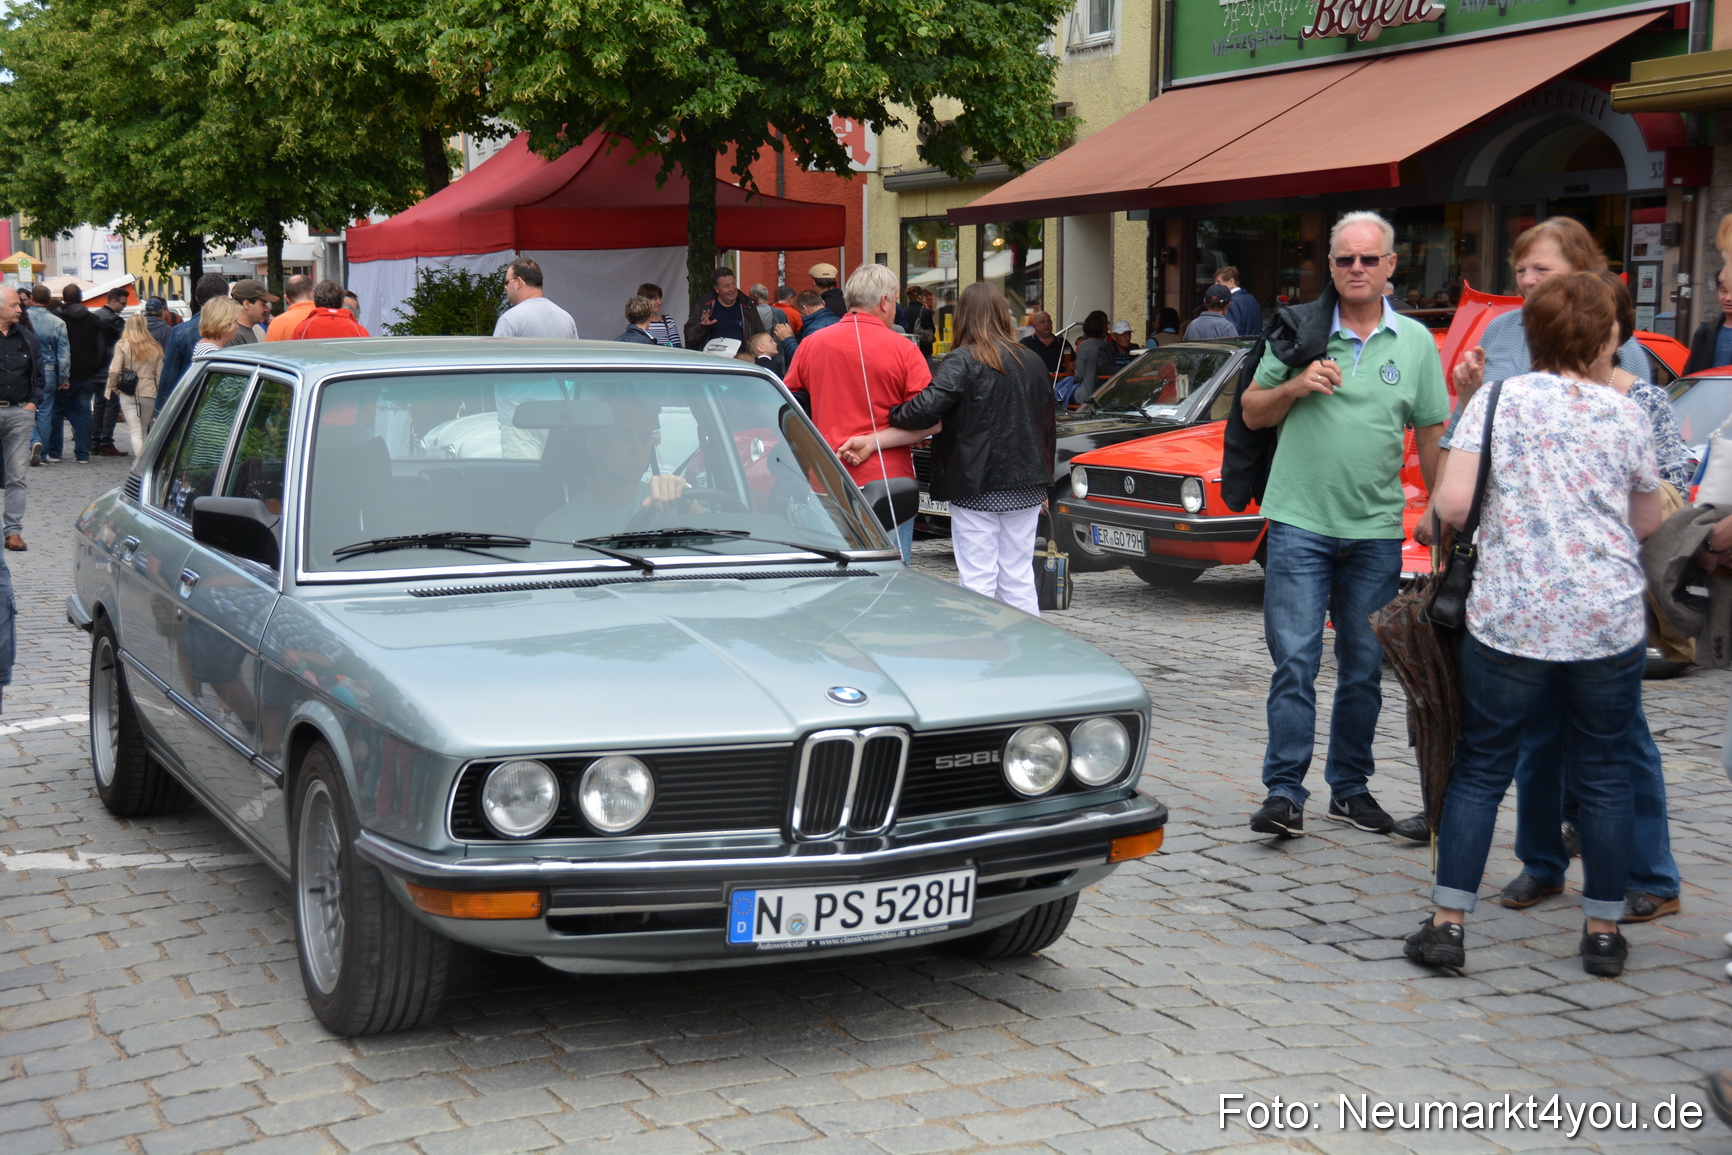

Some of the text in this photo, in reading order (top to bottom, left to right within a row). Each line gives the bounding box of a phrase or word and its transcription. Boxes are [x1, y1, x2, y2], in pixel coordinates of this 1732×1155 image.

[1211, 26, 1287, 57] METZGEREI
[1650, 161, 1664, 180] 33
[1098, 528, 1110, 544] ER
[1126, 532, 1144, 551] 79H
[935, 750, 1001, 770] 528i
[756, 876, 971, 935] N PS 528H
[737, 921, 747, 933] D
[756, 940, 808, 950] Autowerkstatt
